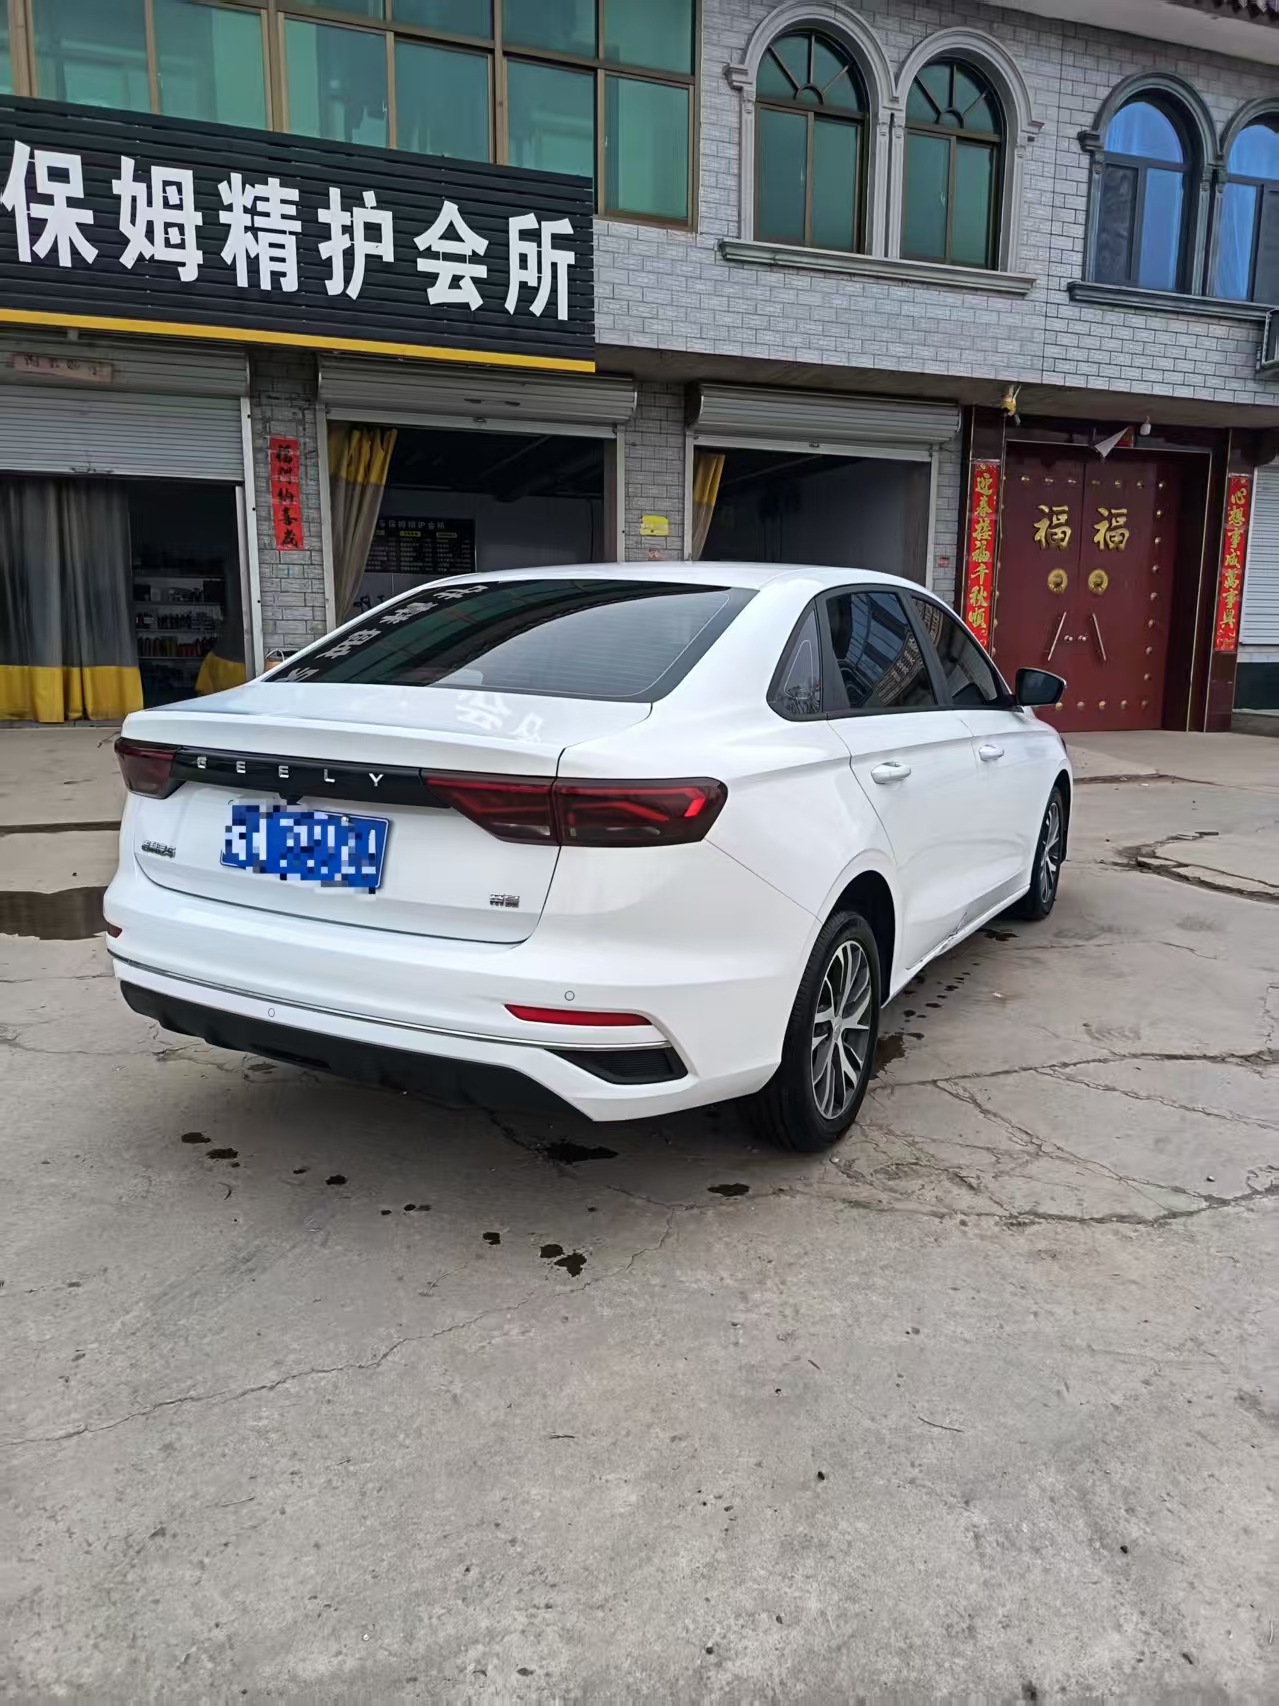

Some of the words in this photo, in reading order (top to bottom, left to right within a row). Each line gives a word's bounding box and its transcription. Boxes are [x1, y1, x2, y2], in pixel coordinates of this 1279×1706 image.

[0, 140, 575, 320] 保姆精护会所
[1033, 504, 1072, 549] 福
[1092, 507, 1130, 551] 福
[197, 756, 384, 787] GEELY
